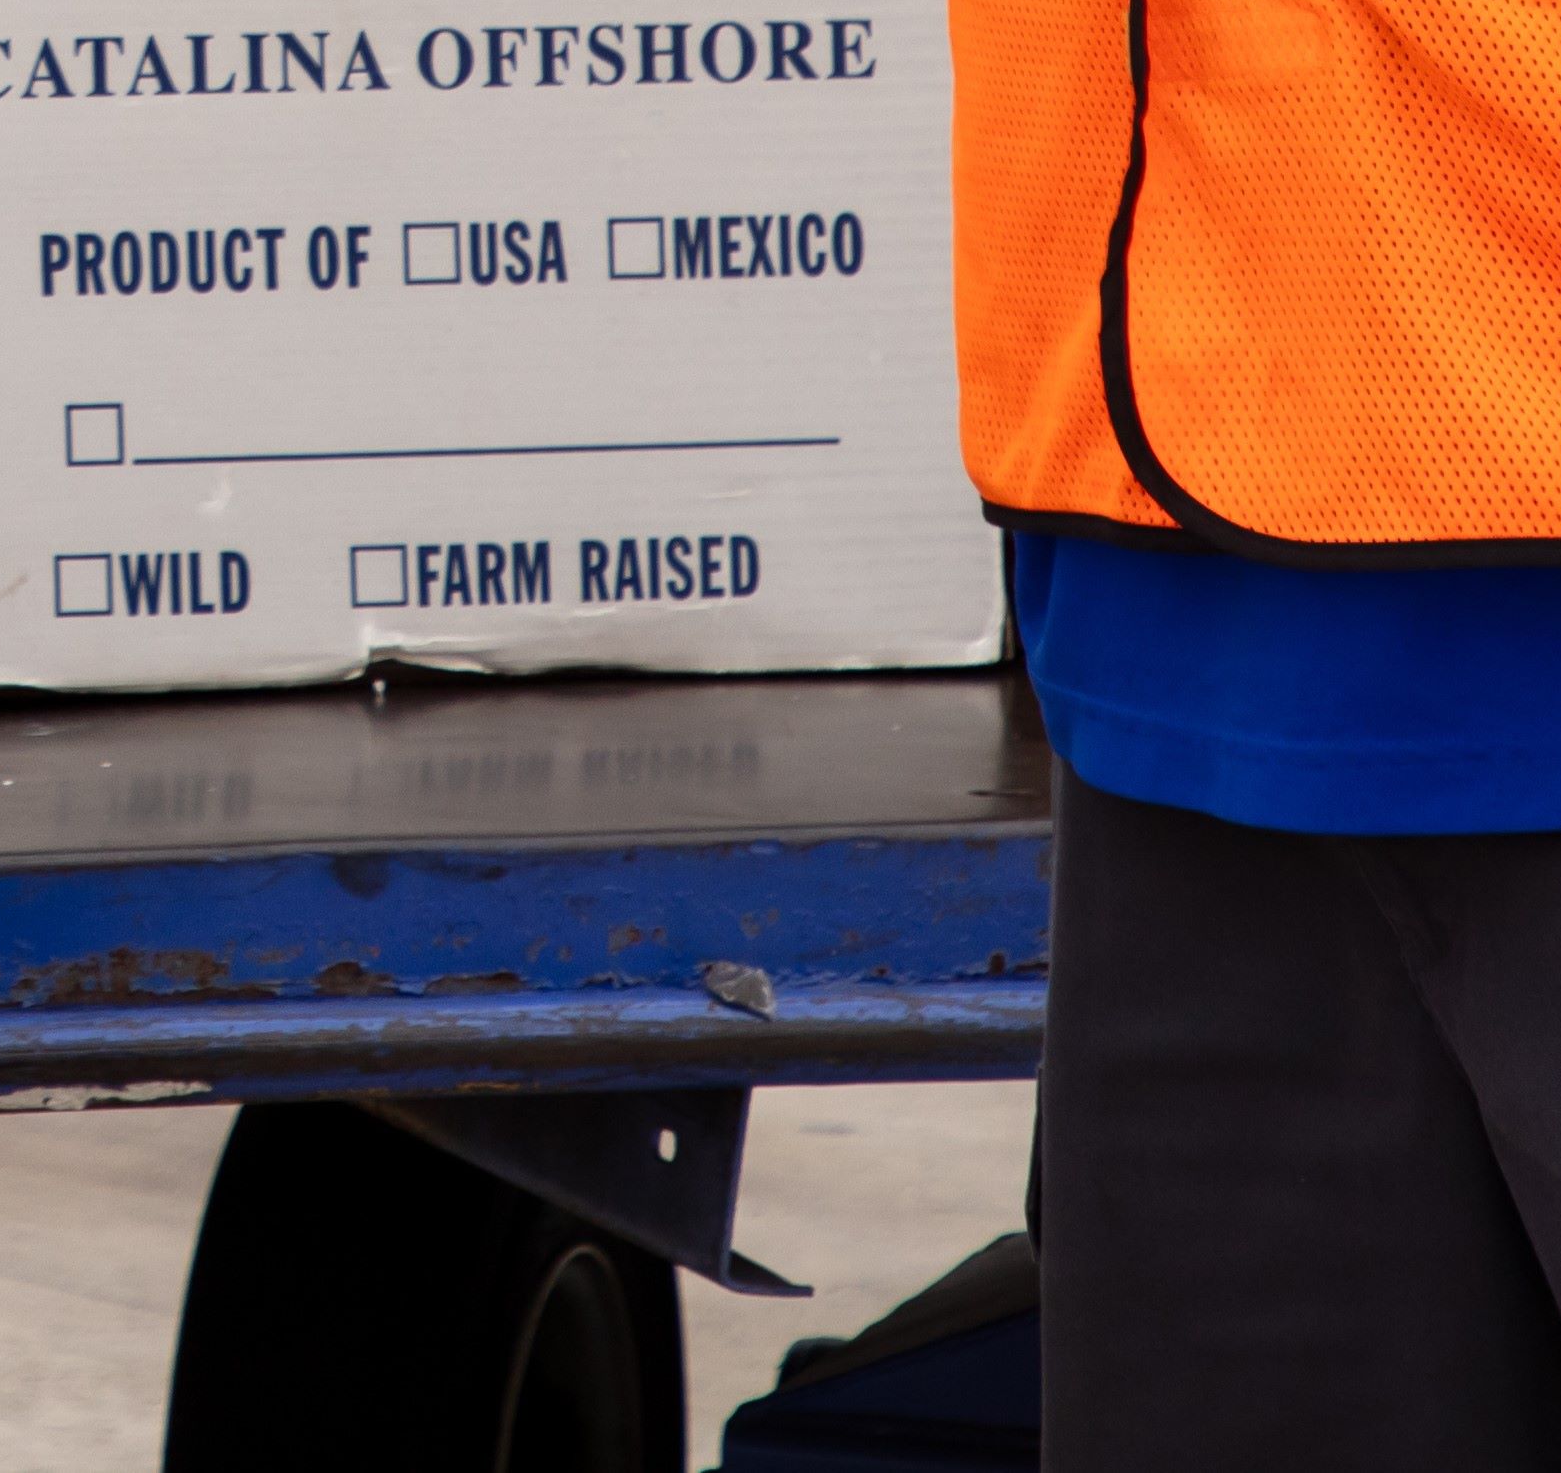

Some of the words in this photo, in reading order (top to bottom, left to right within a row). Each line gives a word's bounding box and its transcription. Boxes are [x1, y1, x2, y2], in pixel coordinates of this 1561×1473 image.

[417, 19, 875, 90] OFFSHORE
[40, 228, 285, 296] PRODUCT
[308, 225, 371, 290] OF
[469, 220, 567, 286] USA
[673, 211, 863, 279] MEXICO
[119, 550, 250, 616] WILD
[416, 540, 551, 607] FARM
[580, 535, 759, 602] RAISED
